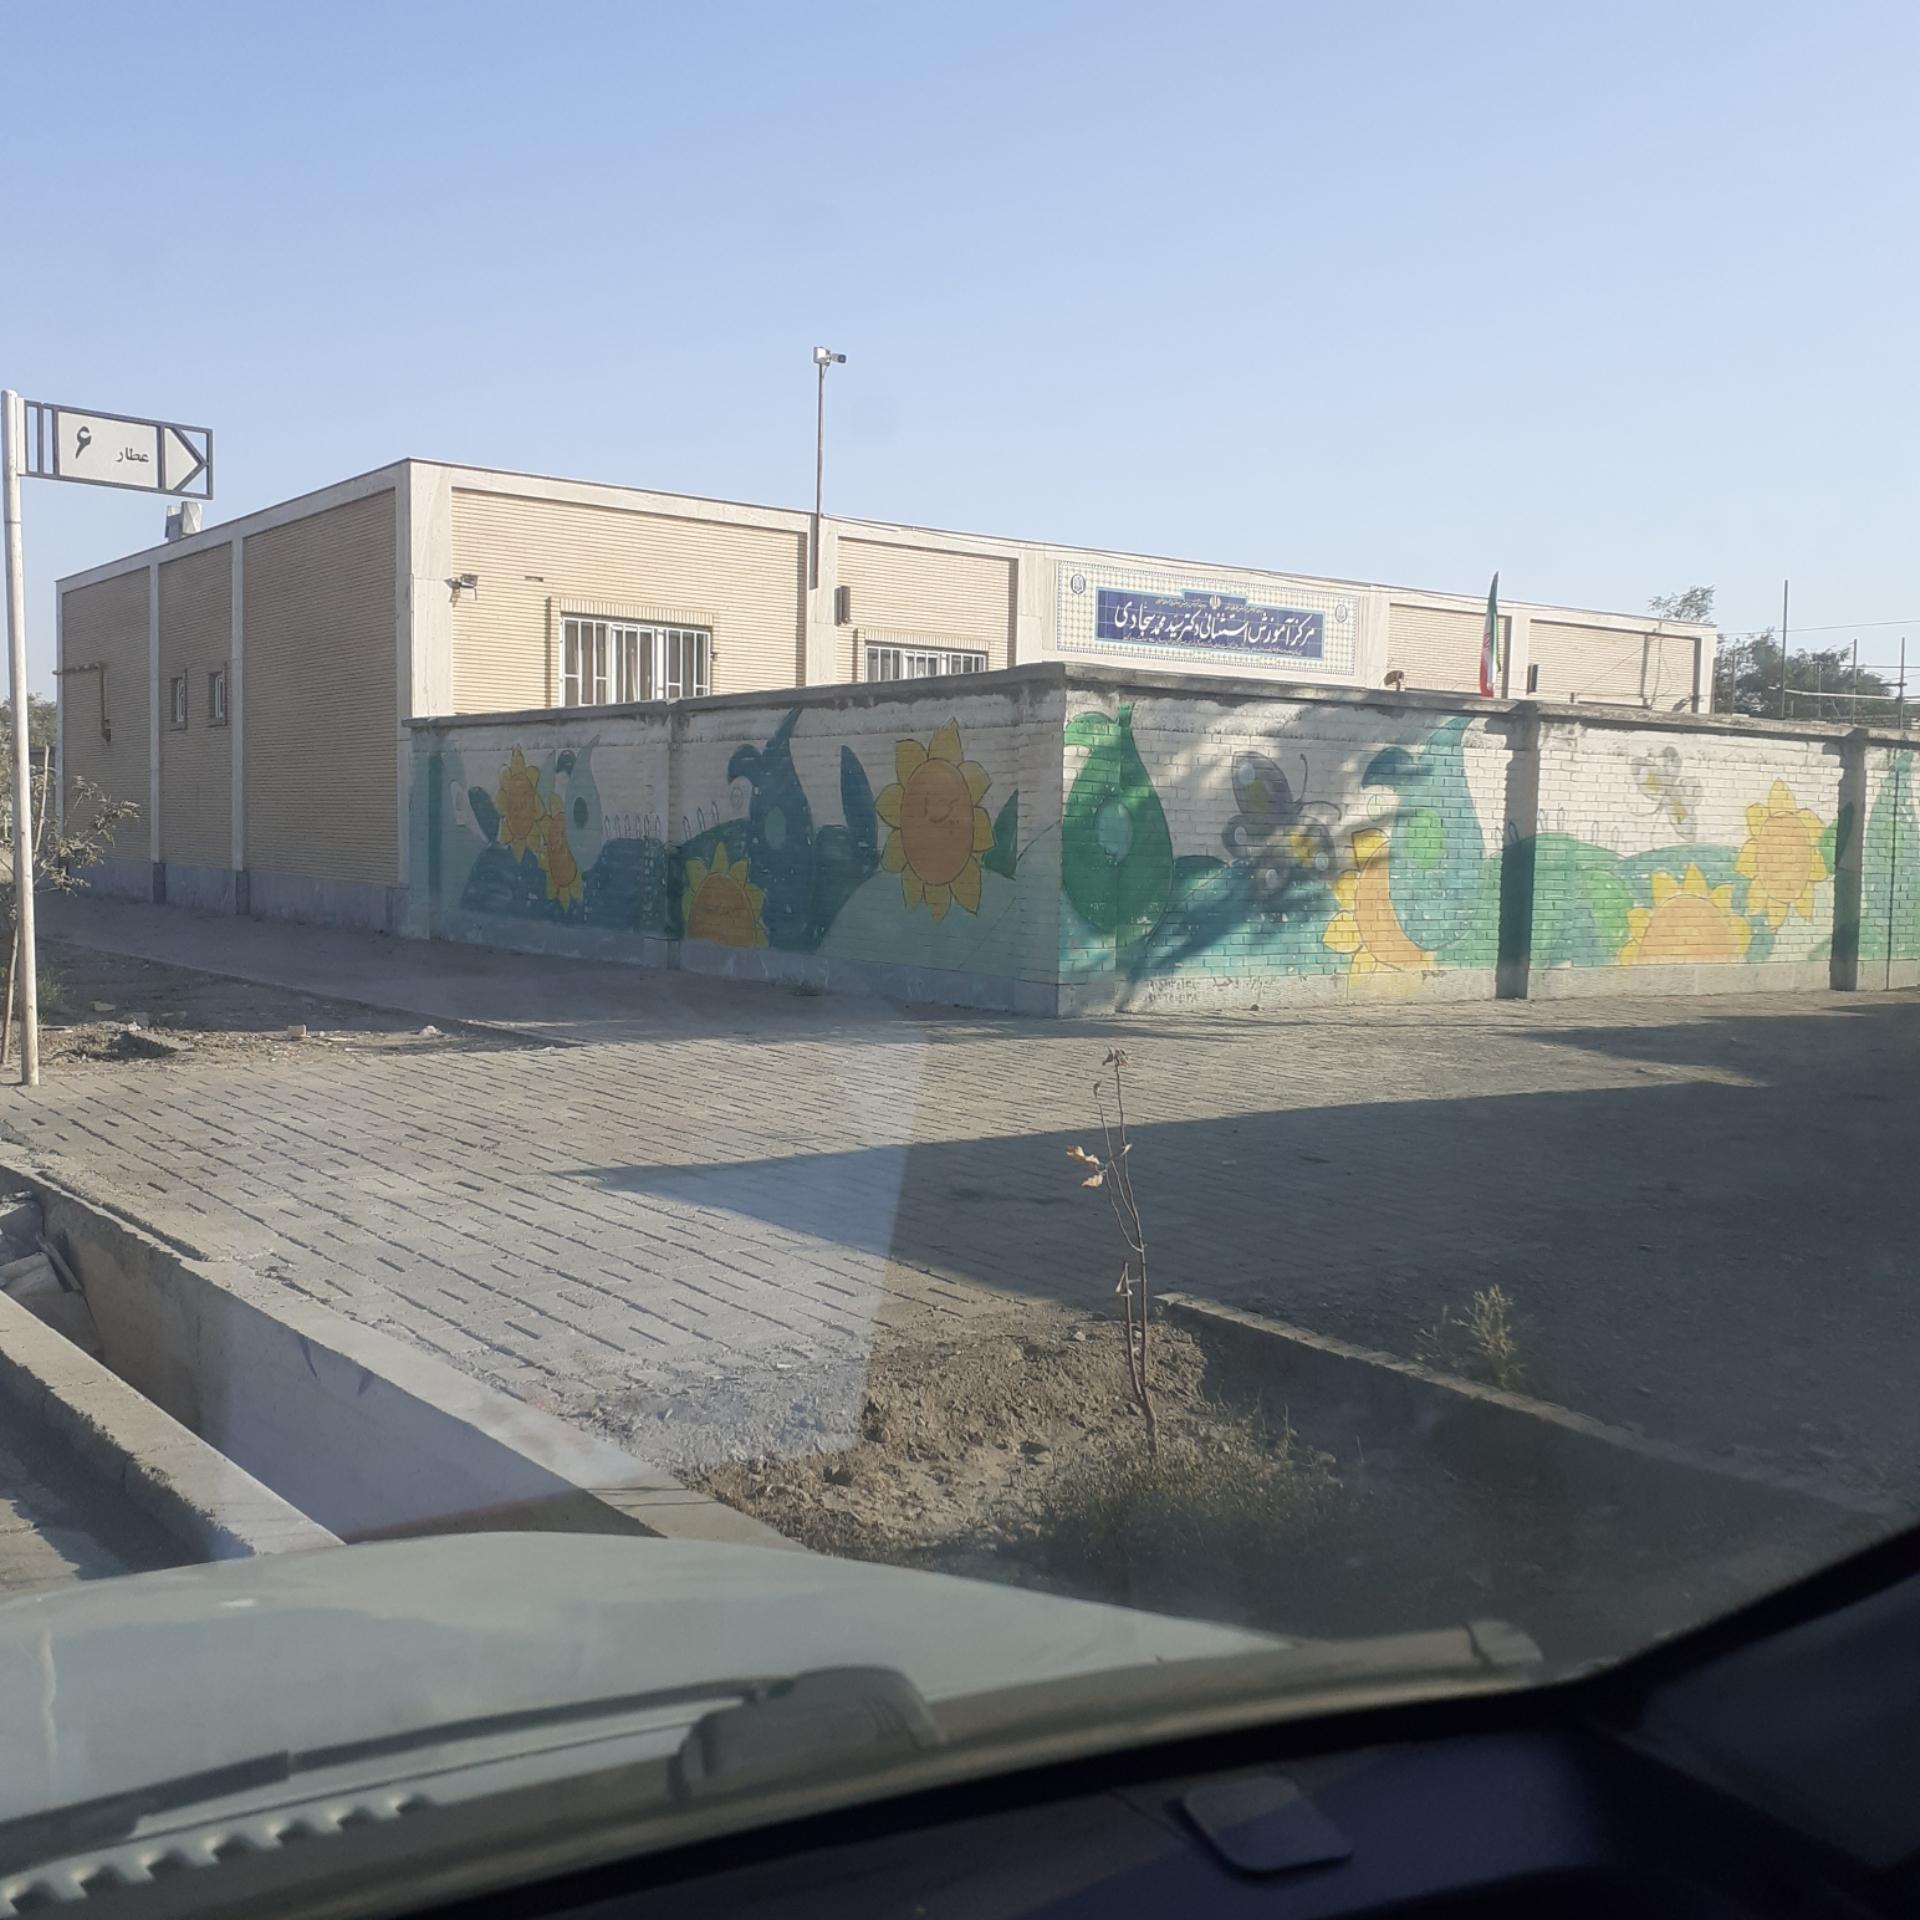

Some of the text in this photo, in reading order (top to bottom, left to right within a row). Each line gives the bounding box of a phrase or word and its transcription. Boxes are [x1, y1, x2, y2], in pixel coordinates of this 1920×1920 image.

[75, 426, 149, 463] عطار ۶
[1114, 601, 1156, 637] سجادی
[1150, 615, 1166, 635] محمد
[1164, 614, 1184, 638] سید
[1177, 609, 1201, 641] دکتر
[1248, 612, 1295, 646] آموزش
[1290, 614, 1315, 646] مرکز
